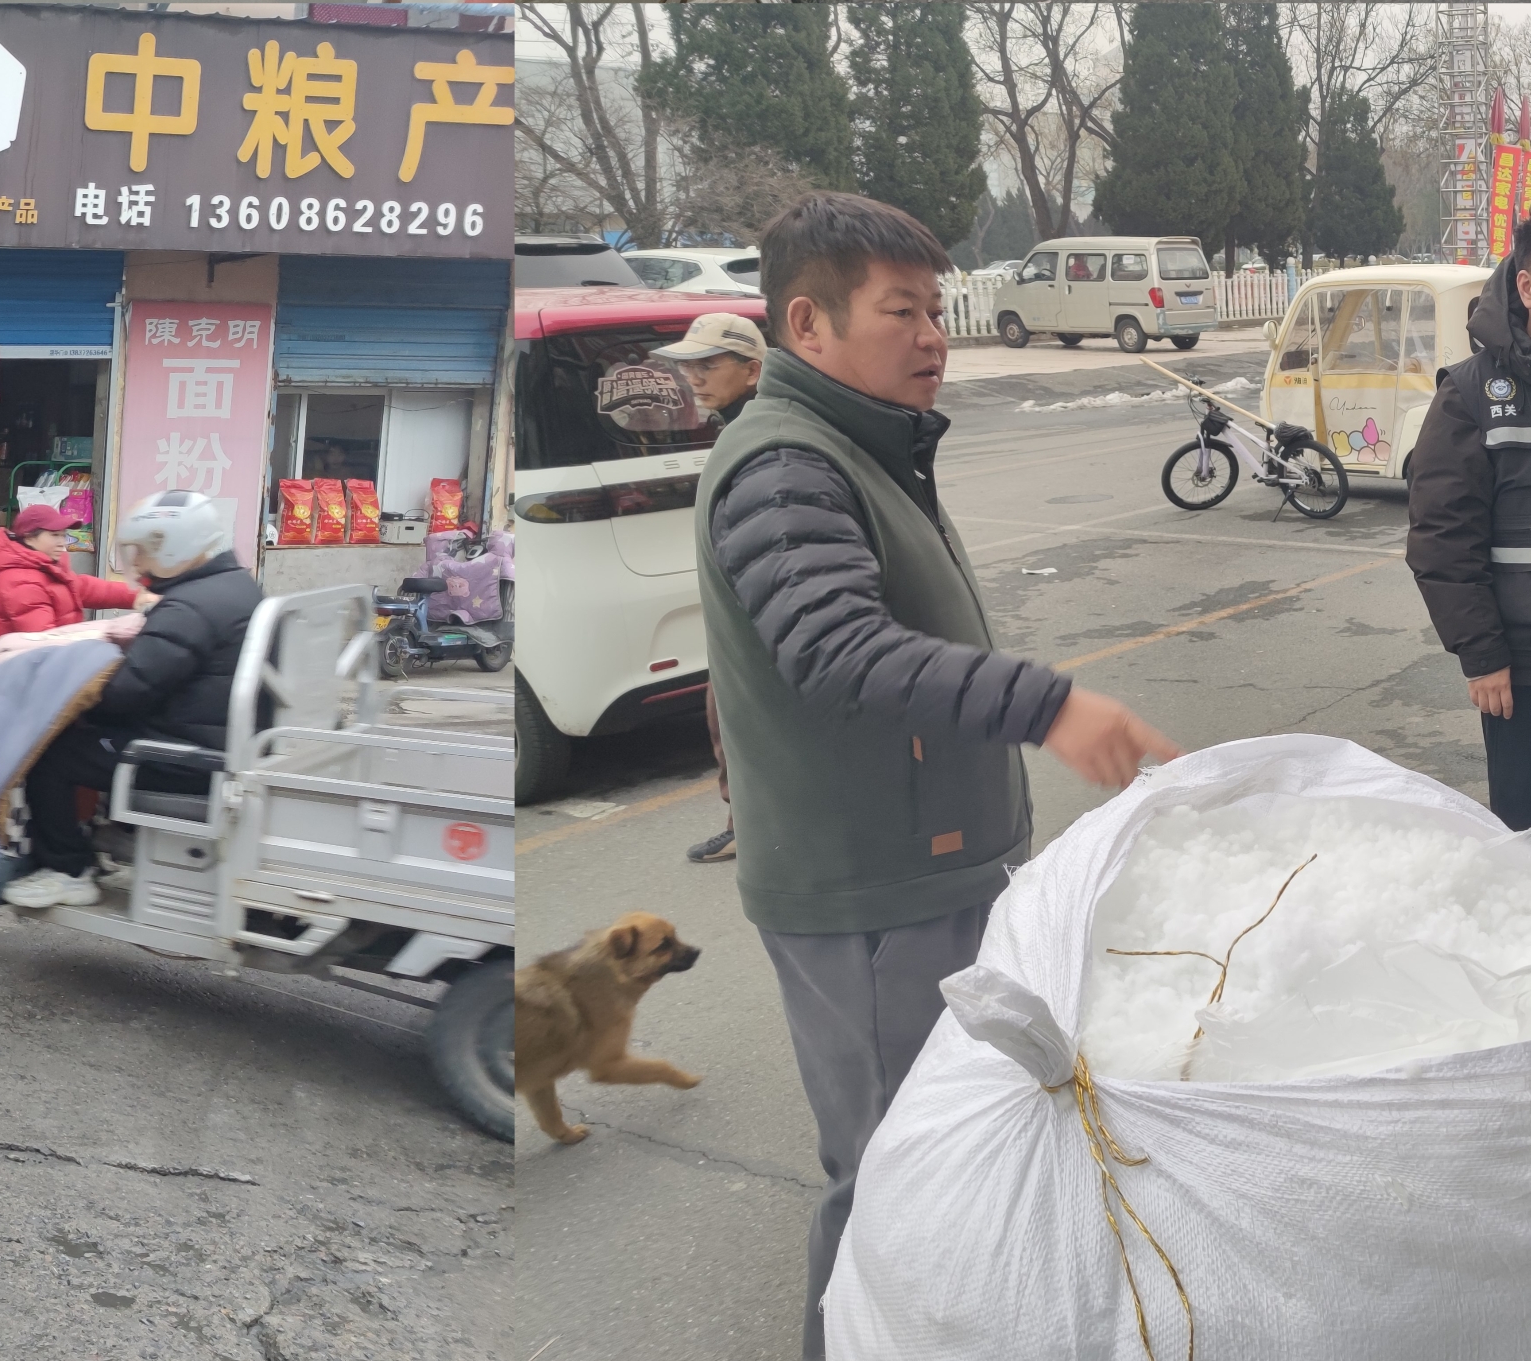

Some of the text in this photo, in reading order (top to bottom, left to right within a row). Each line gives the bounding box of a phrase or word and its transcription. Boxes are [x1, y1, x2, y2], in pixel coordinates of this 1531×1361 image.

[85, 31, 515, 182] 中粮产
[73, 182, 486, 238] 电话 13608628296
[1493, 152, 1515, 211] 昌达家电
[143, 316, 261, 348] 陳克明
[154, 355, 243, 490] 面粉
[1490, 404, 1518, 419] 西关
